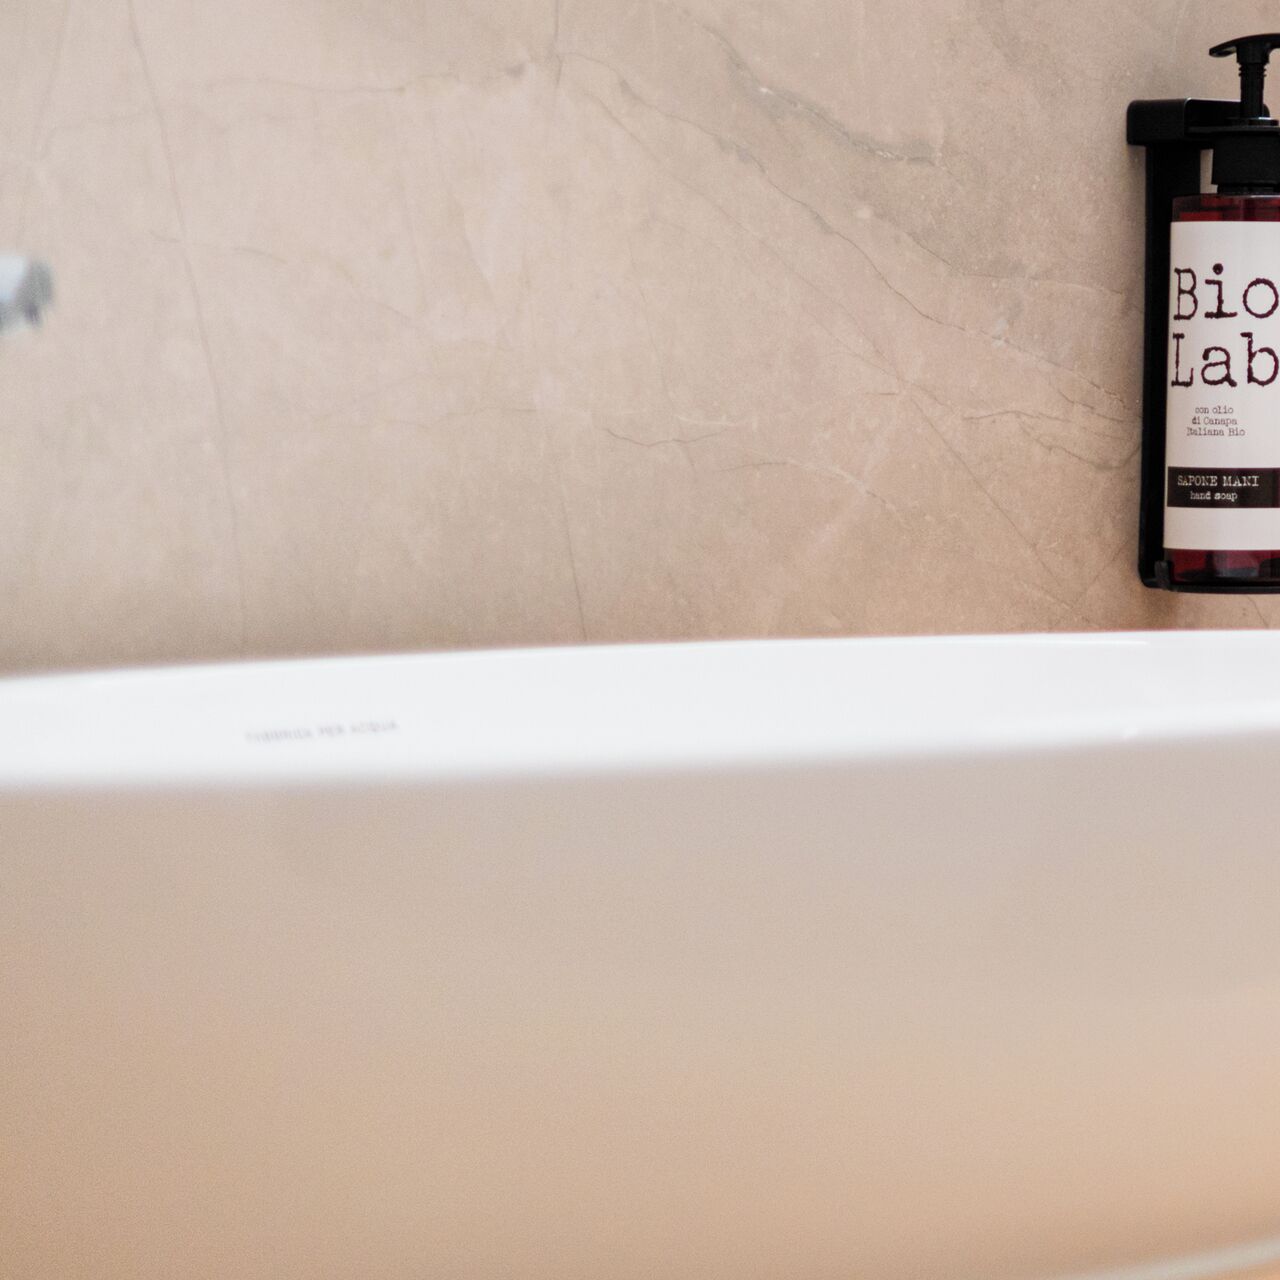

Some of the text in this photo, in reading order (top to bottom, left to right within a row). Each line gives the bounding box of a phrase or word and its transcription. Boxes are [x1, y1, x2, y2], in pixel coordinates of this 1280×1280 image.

[1173, 263, 1280, 320] Bio
[1171, 332, 1280, 387] Lab
[1212, 405, 1234, 414] olio
[1203, 416, 1238, 427] Canapa
[1228, 427, 1246, 437] Bio
[1177, 475, 1260, 487] SAPONE MANI
[1190, 491, 1238, 502] hand soap
